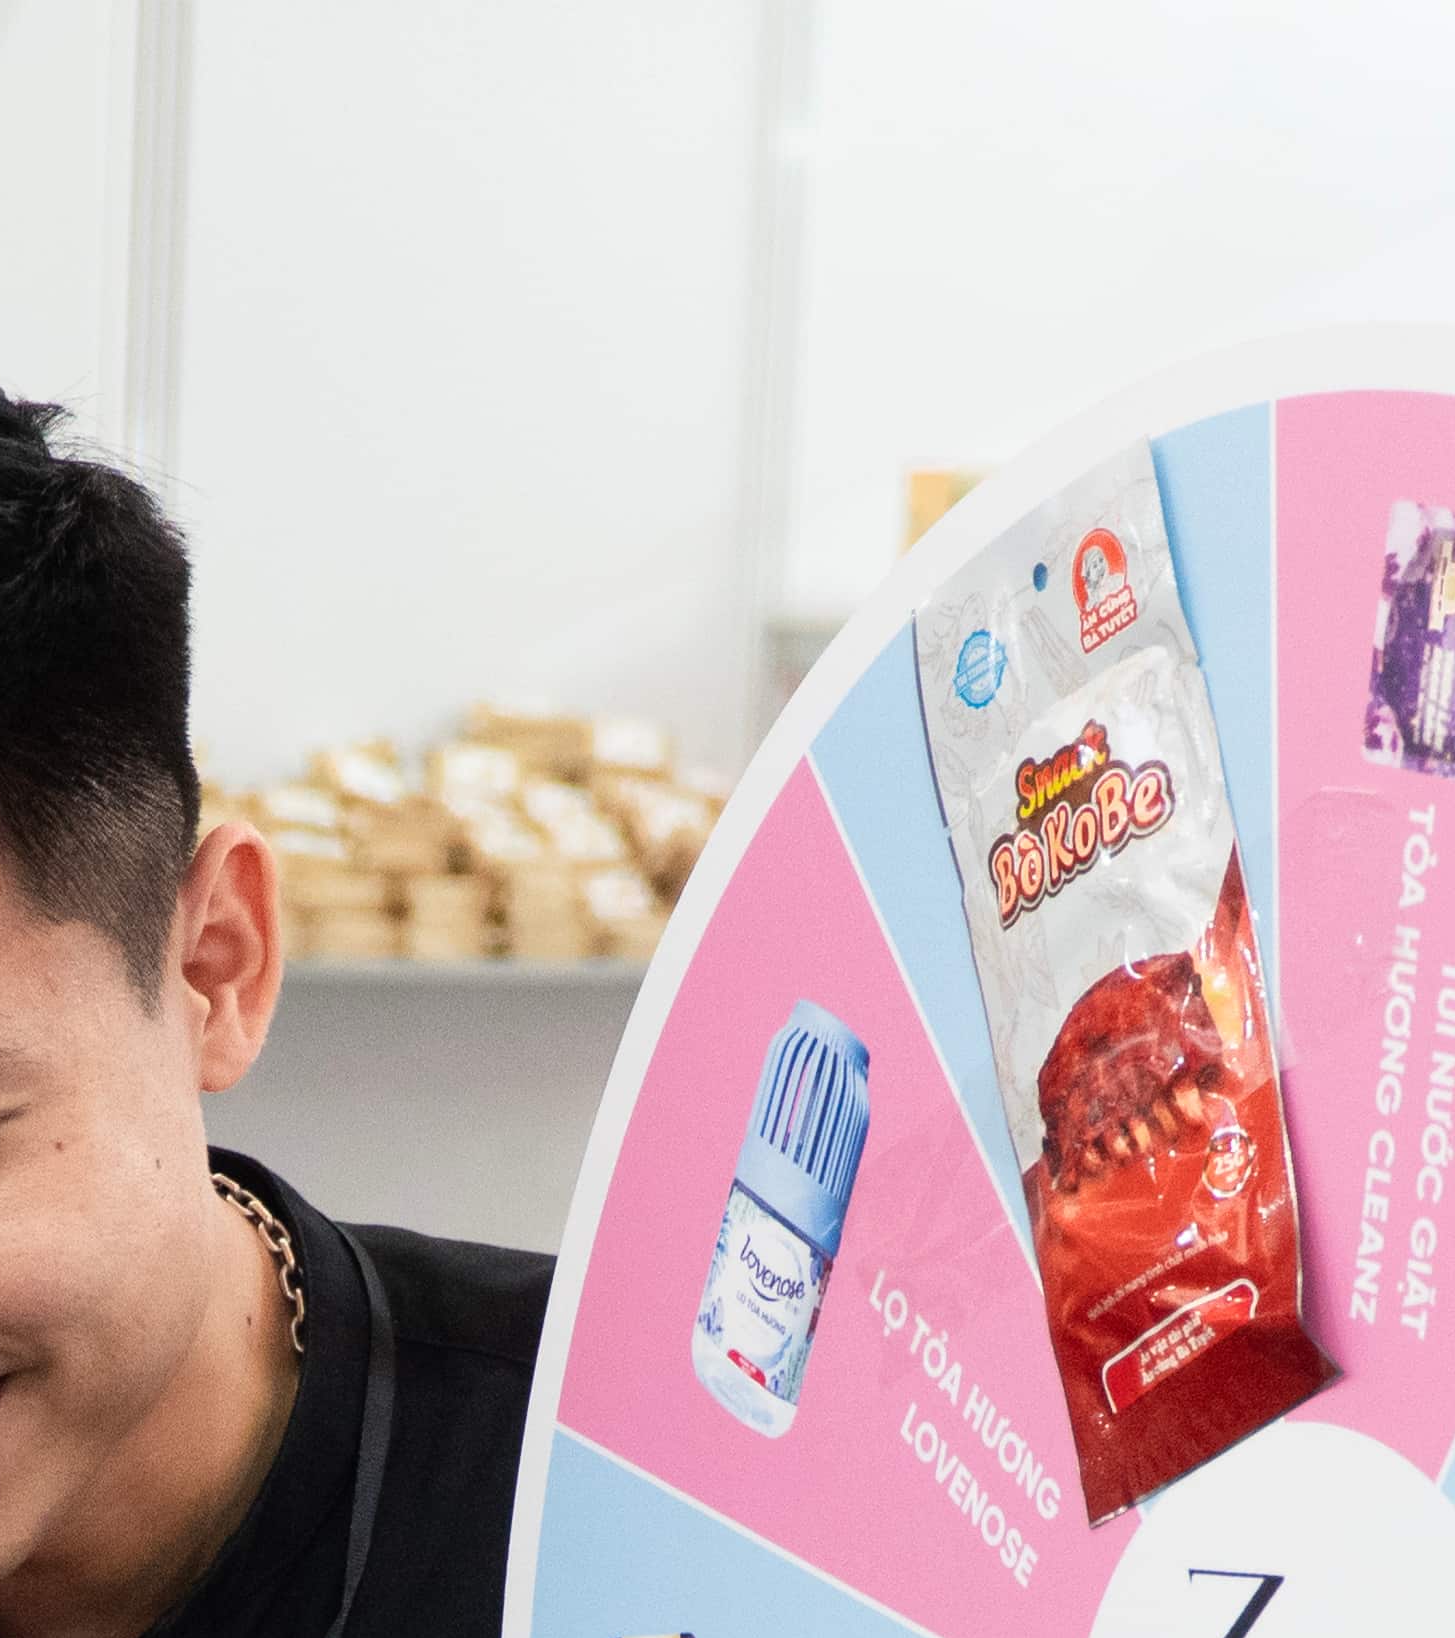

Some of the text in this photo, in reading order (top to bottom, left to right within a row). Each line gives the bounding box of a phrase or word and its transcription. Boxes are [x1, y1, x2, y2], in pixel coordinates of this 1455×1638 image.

[1399, 804, 1438, 909] TỎA
[1374, 923, 1421, 1117] HƯƠNG
[1349, 1129, 1396, 1325] CLEANZ
[1396, 1216, 1438, 1341] GIẶT
[869, 1269, 1061, 1521] LỌ TỎA HƯƠNG
[900, 1401, 1038, 1588] LOVENOSE
